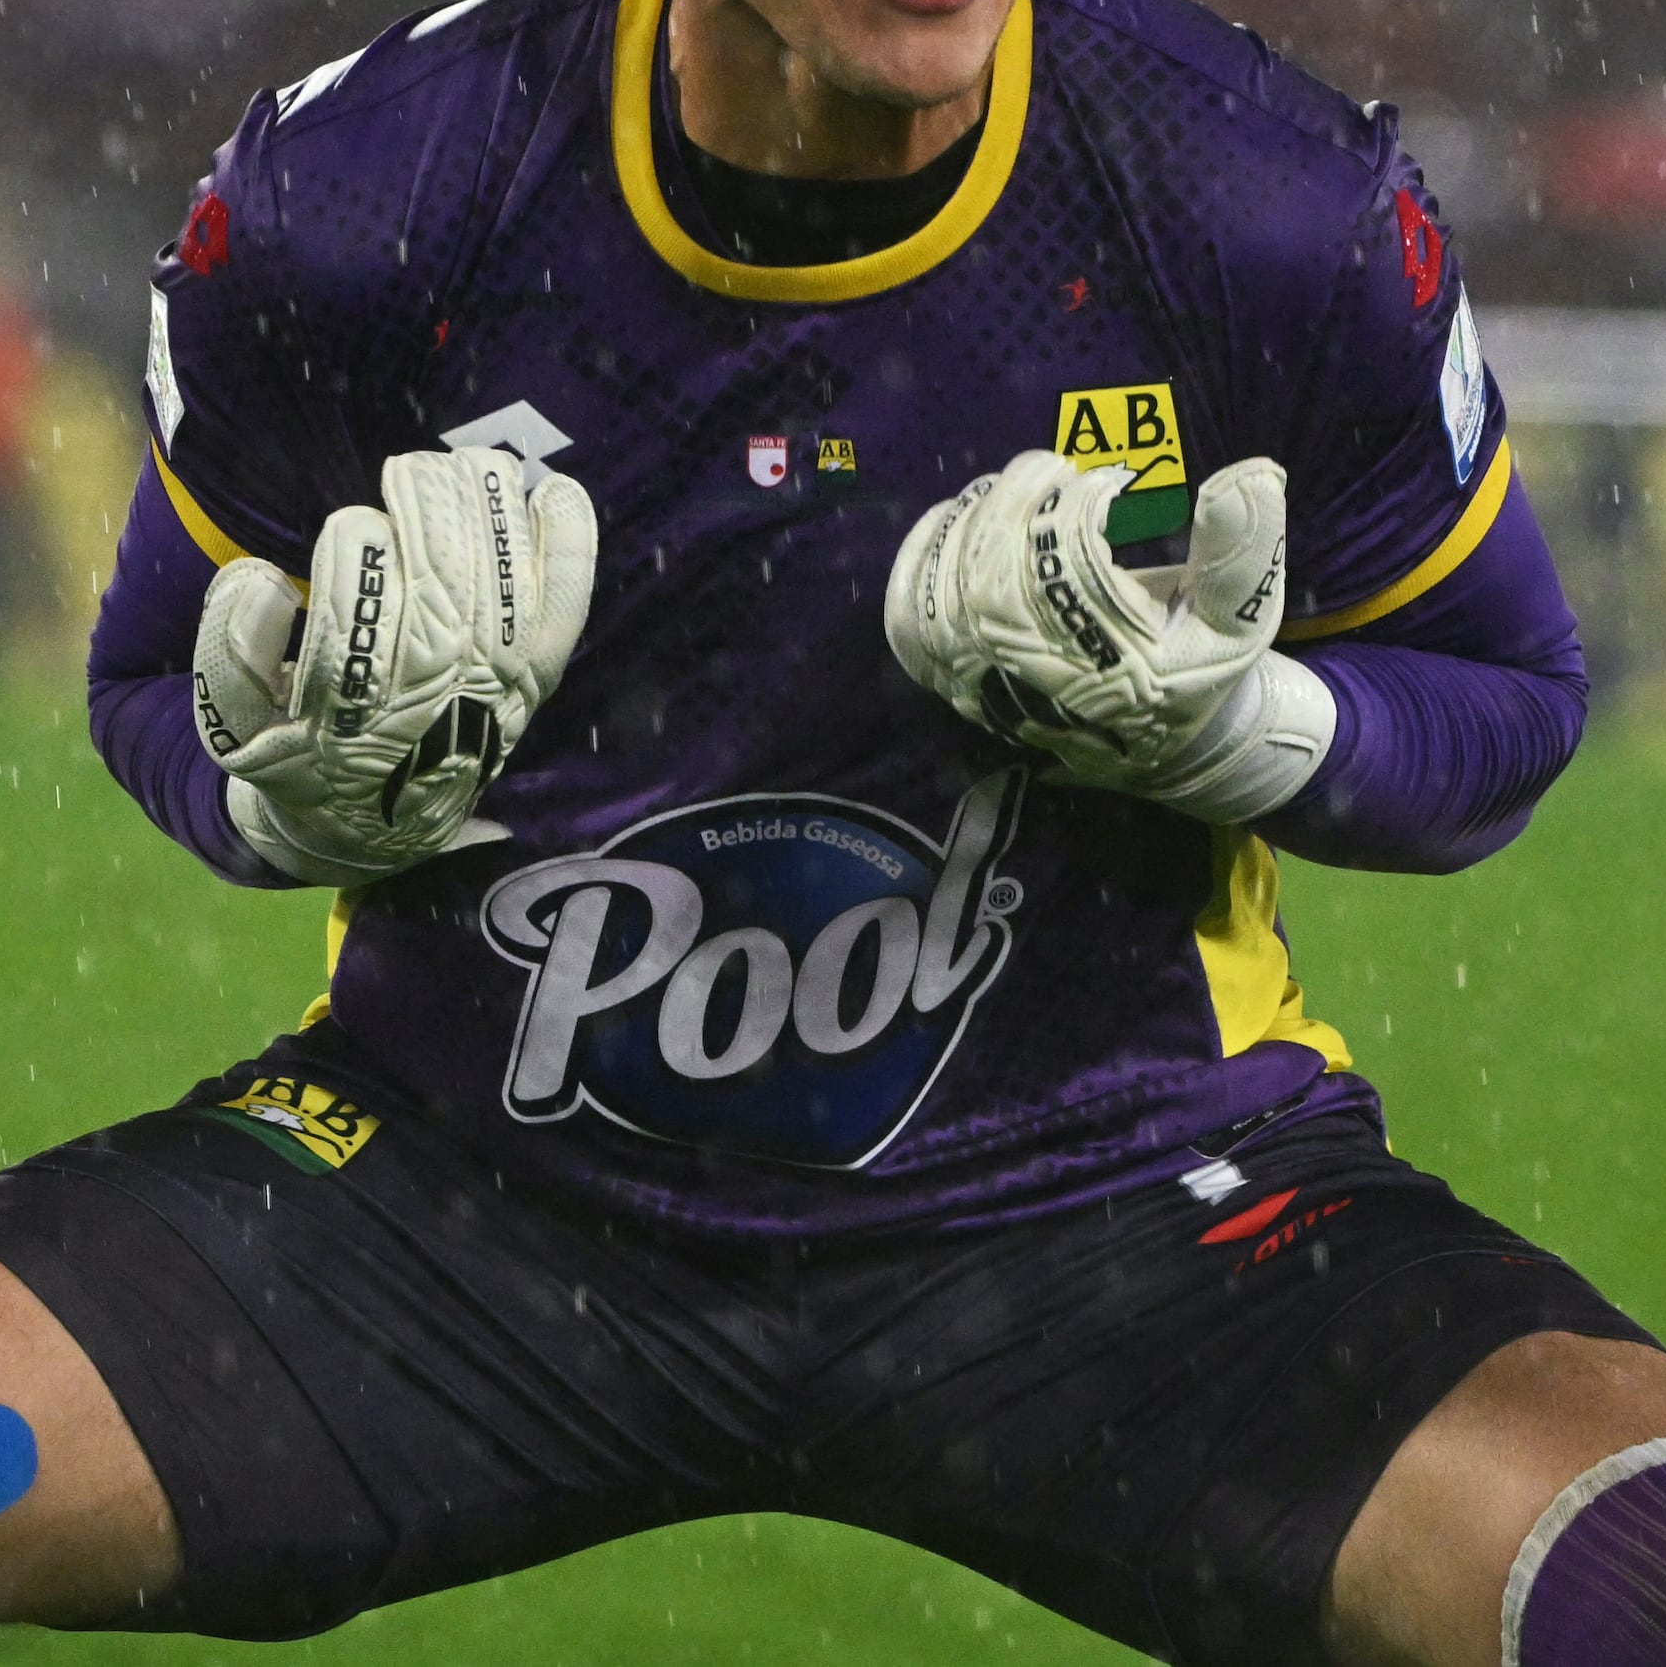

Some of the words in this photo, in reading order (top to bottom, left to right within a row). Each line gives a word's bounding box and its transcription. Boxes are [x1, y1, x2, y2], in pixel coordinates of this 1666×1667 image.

[749, 437, 774, 448] SANTA
[484, 470, 515, 647] GUERRERO
[1235, 534, 1284, 624] PRO
[341, 544, 386, 700] SOCCER
[194, 671, 242, 758] PRO
[700, 819, 798, 852] Bebida
[803, 821, 905, 881] Gaseosa
[489, 772, 1011, 1101] Pool
